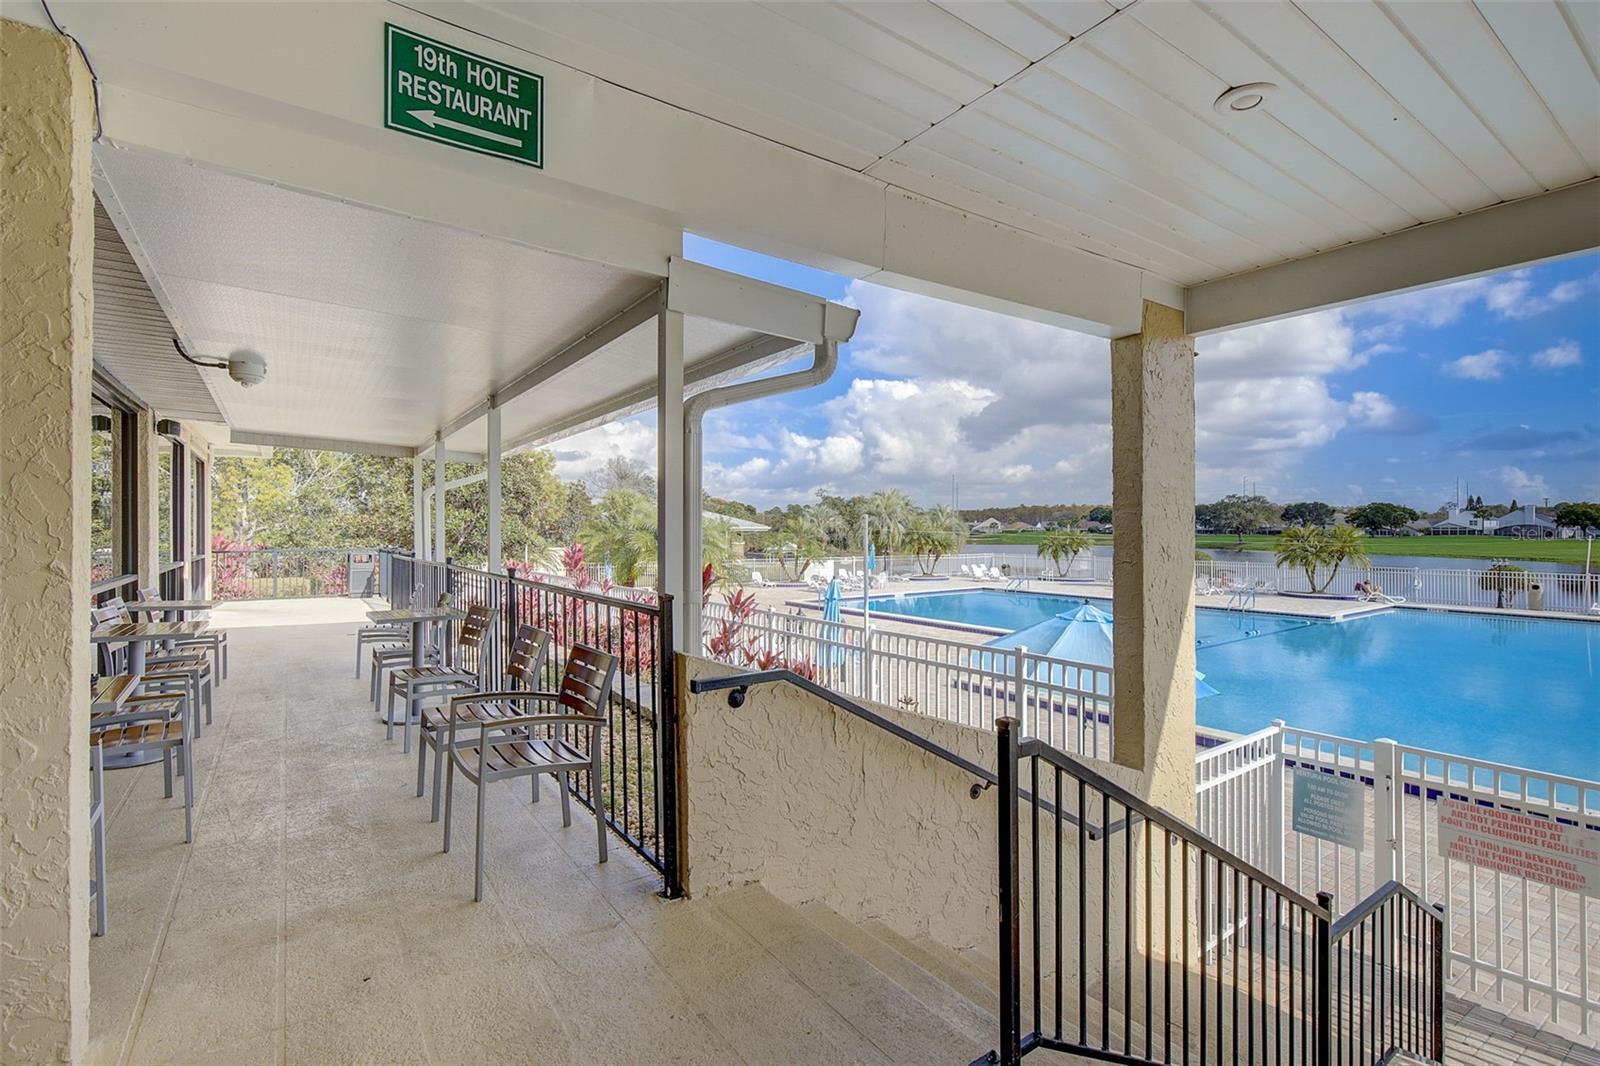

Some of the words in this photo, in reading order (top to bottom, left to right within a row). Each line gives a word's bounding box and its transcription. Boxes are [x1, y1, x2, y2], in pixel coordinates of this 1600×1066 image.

[414, 45, 458, 79] 19th
[467, 61, 520, 99] HOLE
[398, 70, 532, 131] RESTAURANT
[1442, 798, 1480, 814] OUTSIDE
[1484, 808, 1507, 820] FOOD
[1510, 813, 1530, 826] AND
[1450, 809, 1467, 820] ARE
[1469, 813, 1488, 825] NOT
[1491, 818, 1546, 838] PERMITTED
[1549, 831, 1561, 842] AT
[1440, 815, 1462, 827] POOL
[1465, 821, 1478, 831] OR
[1480, 824, 1538, 846] CLUBHOUSE
[1457, 834, 1473, 845] ALL
[1475, 838, 1499, 852] FOOD
[1502, 845, 1521, 858] AND
[1447, 849, 1463, 860] THE
[1465, 853, 1521, 876] CLUBHOUSE
[1449, 841, 1476, 855] MUST
[1478, 848, 1489, 858] BE
[1492, 852, 1552, 875] PURCHASED
[1555, 868, 1585, 884] FROM
